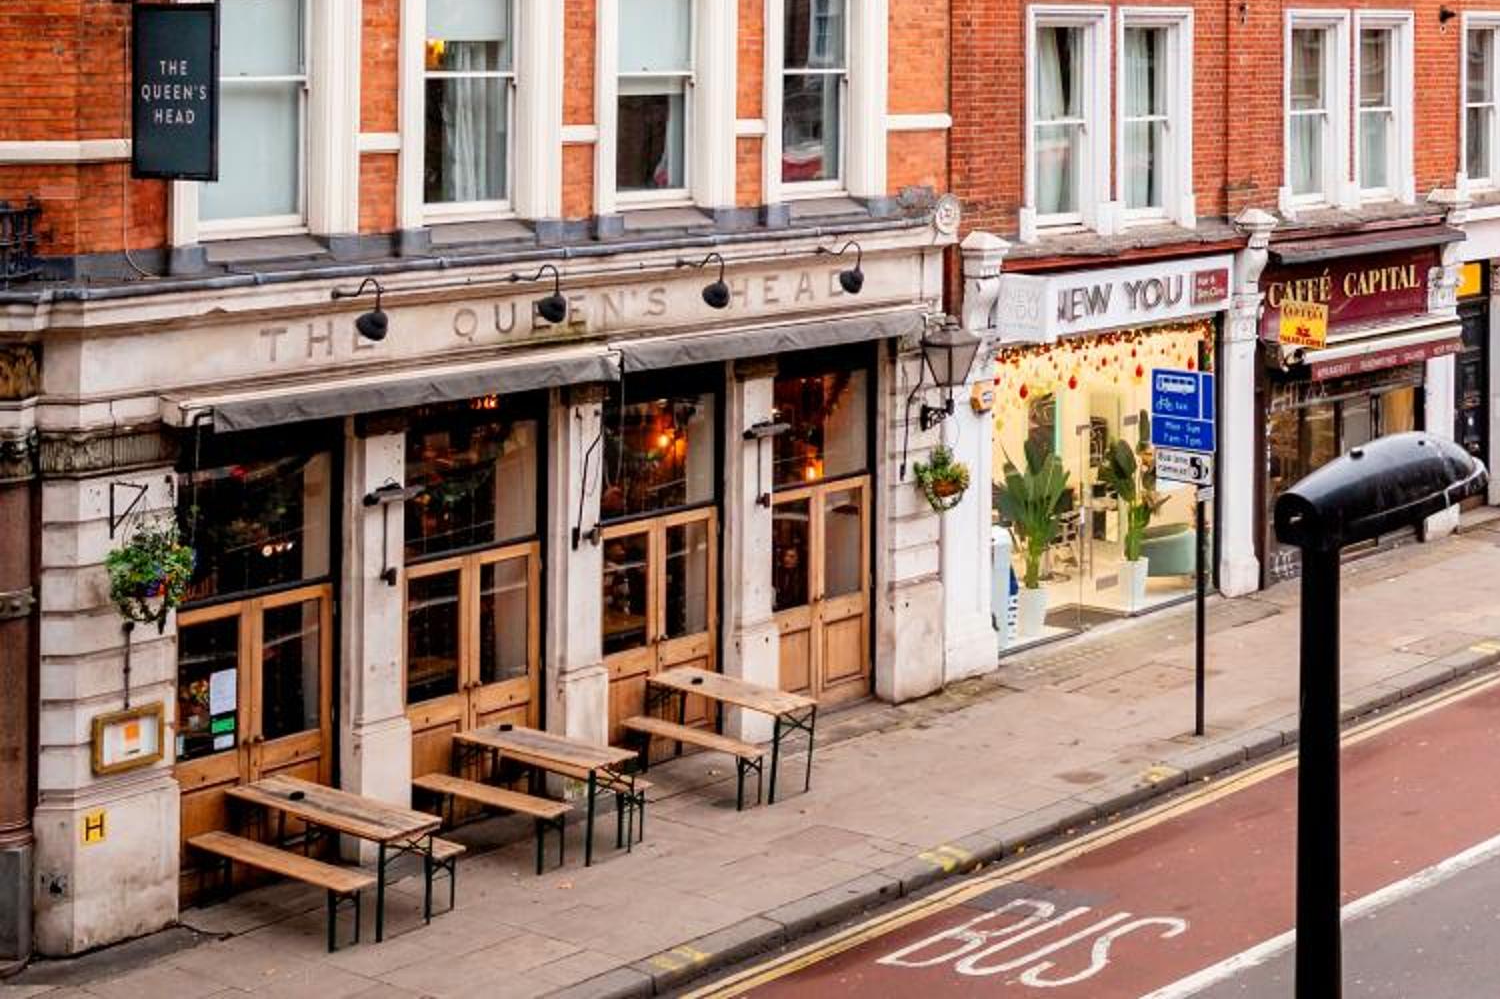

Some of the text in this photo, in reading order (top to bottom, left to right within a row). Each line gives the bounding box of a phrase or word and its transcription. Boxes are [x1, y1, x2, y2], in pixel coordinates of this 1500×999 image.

[160, 60, 188, 75] THE
[141, 84, 207, 102] QUEEN'S
[154, 108, 195, 124] HEAD
[1123, 274, 1183, 312] YOU
[1268, 264, 1421, 308] CAFFÉ CAPITAL
[453, 287, 667, 342] QUEEN'S
[875, 898, 1188, 987] BUS
